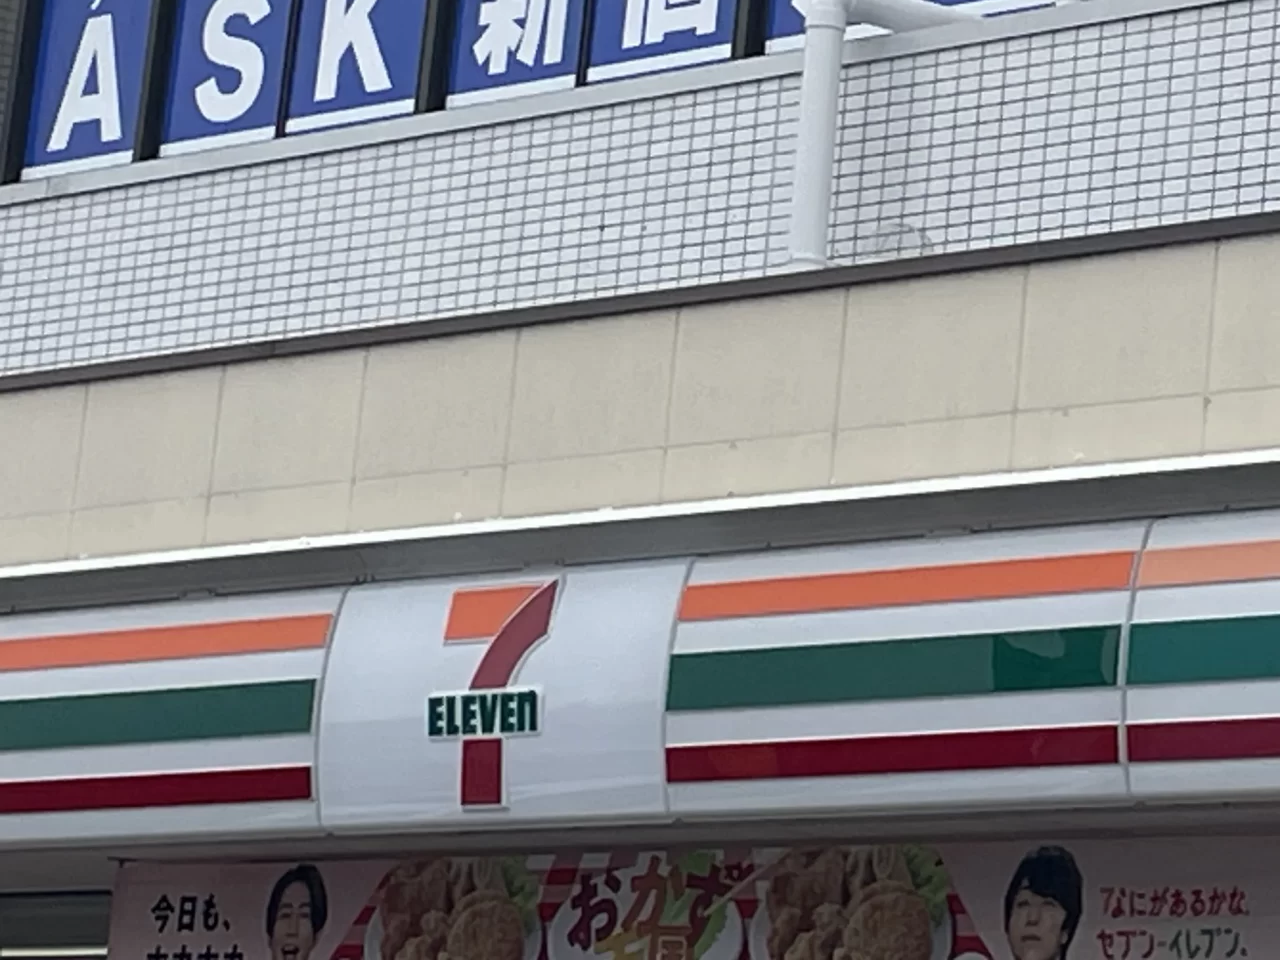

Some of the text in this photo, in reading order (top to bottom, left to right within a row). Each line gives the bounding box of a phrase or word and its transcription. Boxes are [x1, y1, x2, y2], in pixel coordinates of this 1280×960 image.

[443, 579, 559, 807] 7
[150, 893, 231, 934] 今日も、
